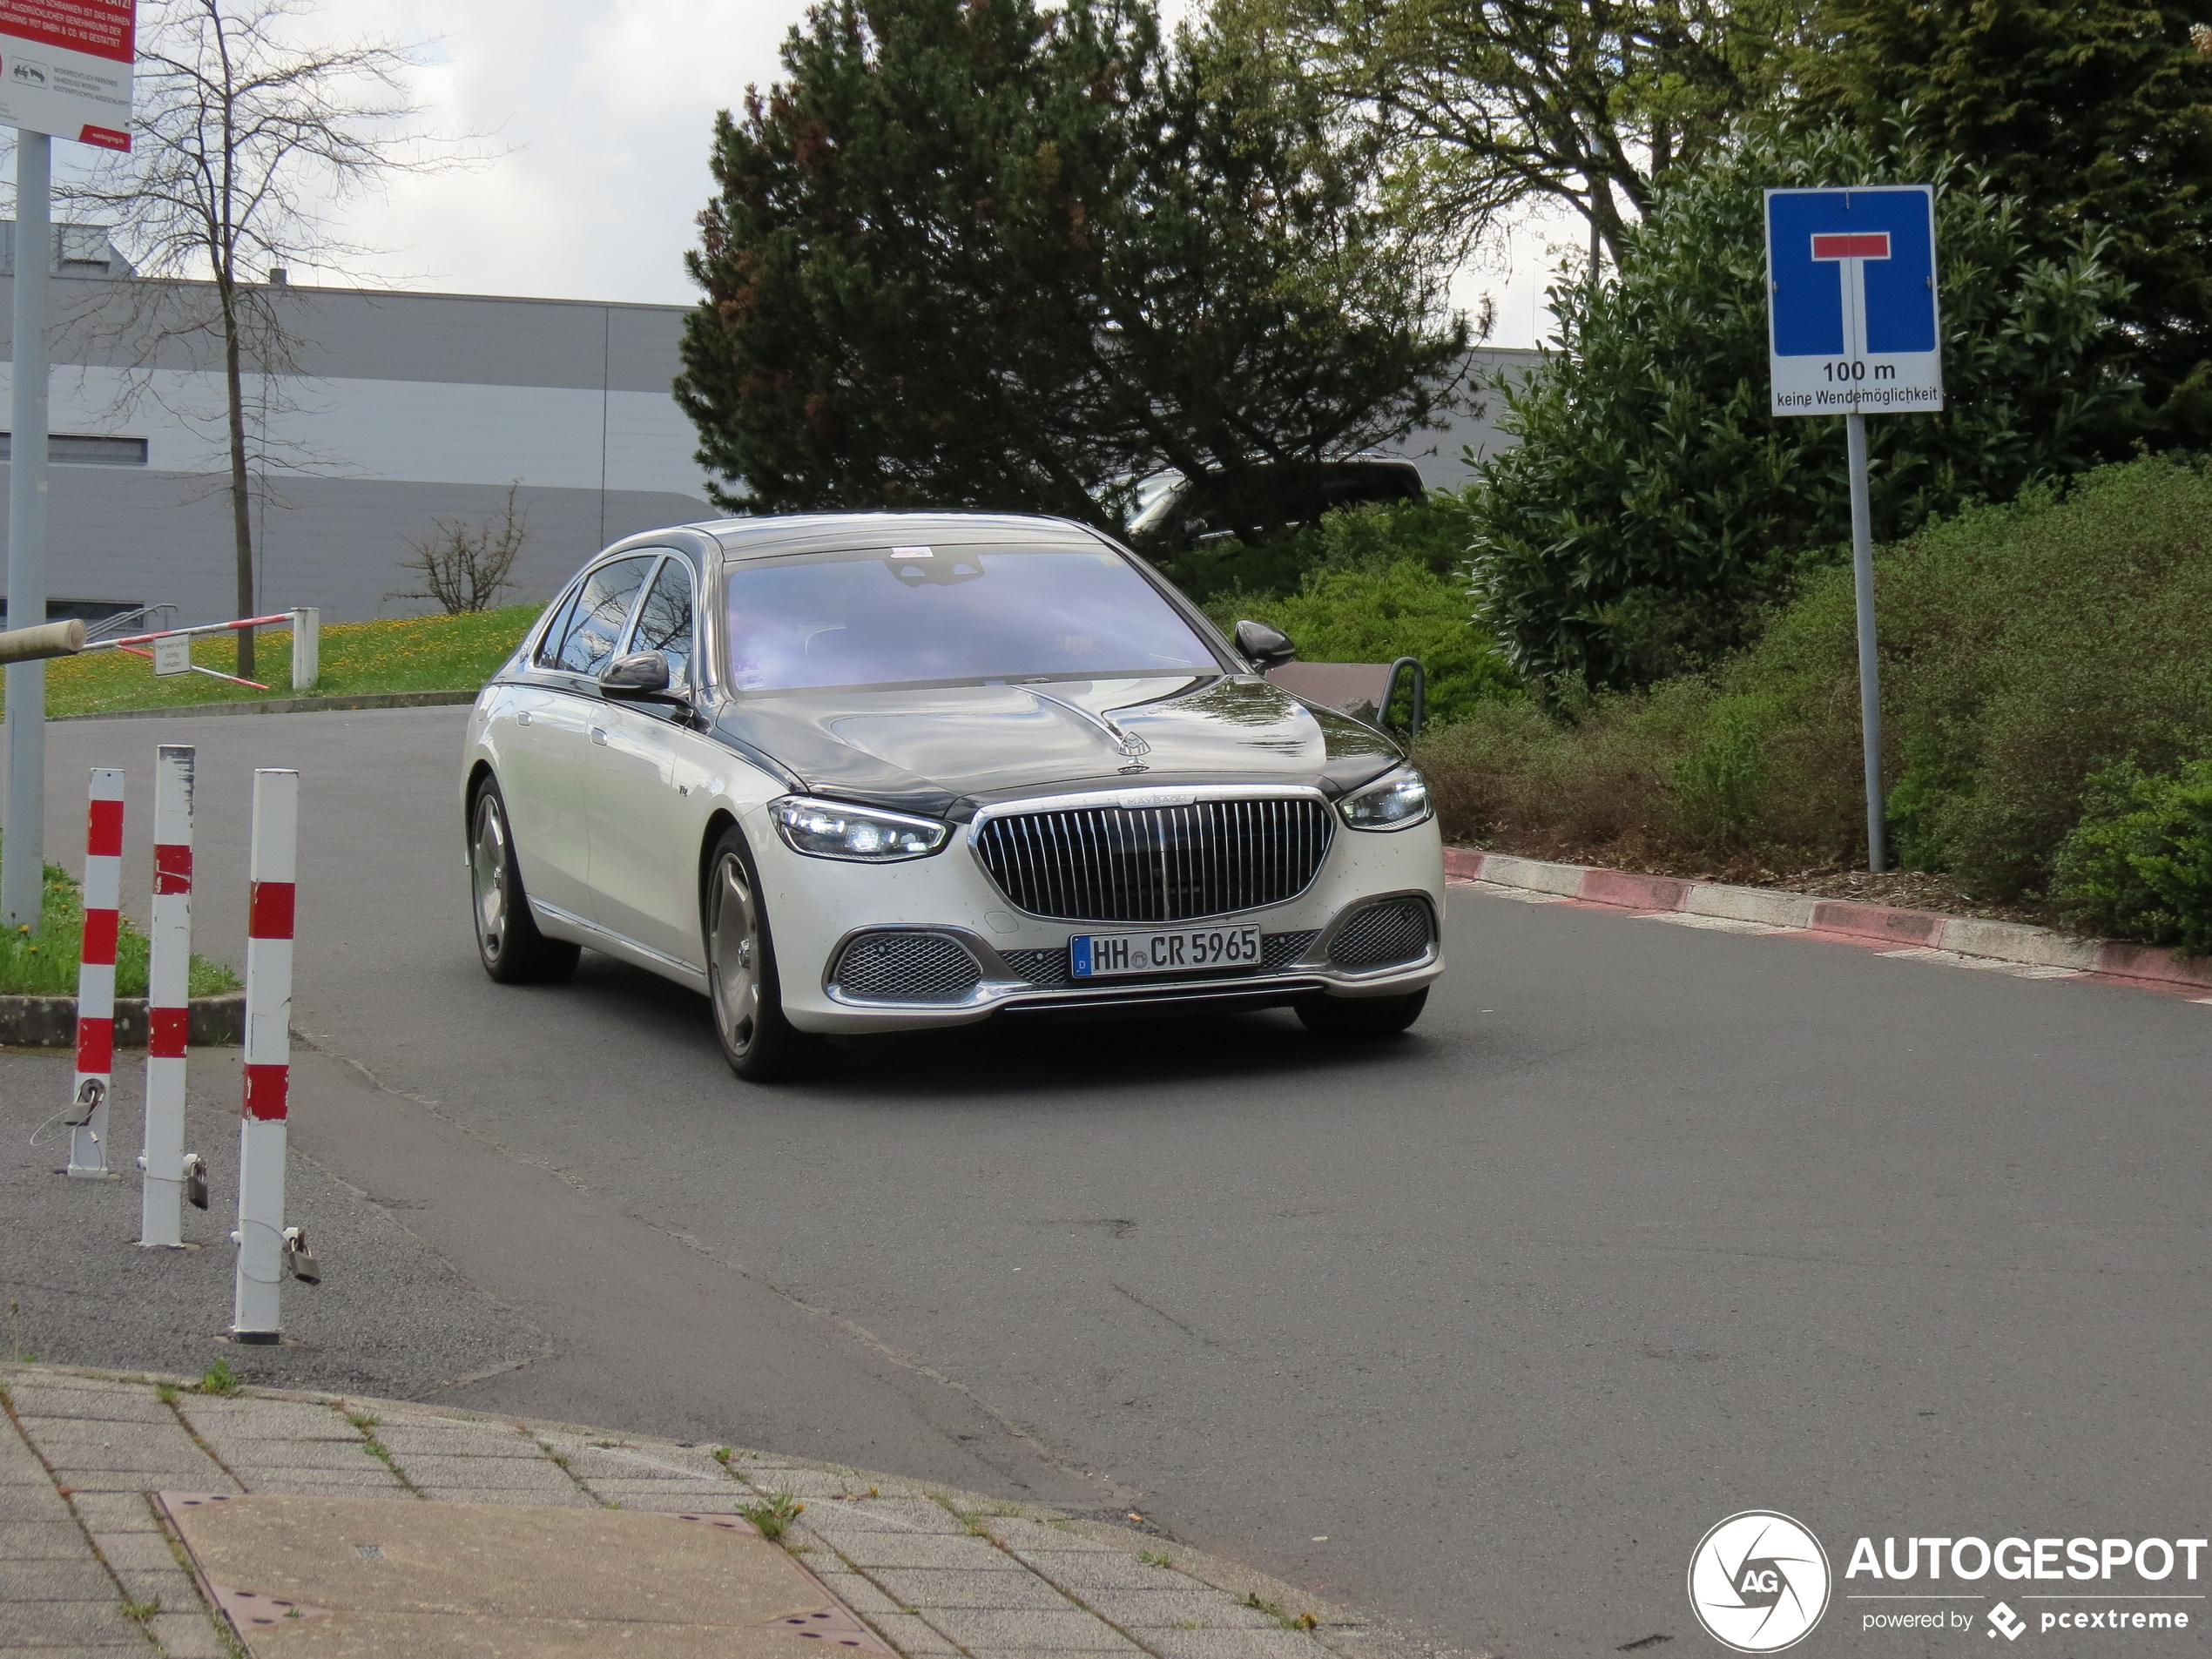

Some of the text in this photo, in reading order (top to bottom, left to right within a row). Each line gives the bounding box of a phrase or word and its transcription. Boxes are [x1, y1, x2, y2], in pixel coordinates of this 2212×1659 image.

[93, 10, 105, 20] DAS
[107, 13, 131, 26] PARKEN
[109, 26, 122, 37] DER
[1823, 361, 1896, 381] 100 m
[1777, 387, 1938, 407] keine Wendemöglichkeit
[1078, 929, 1257, 970] D HH CR 5965
